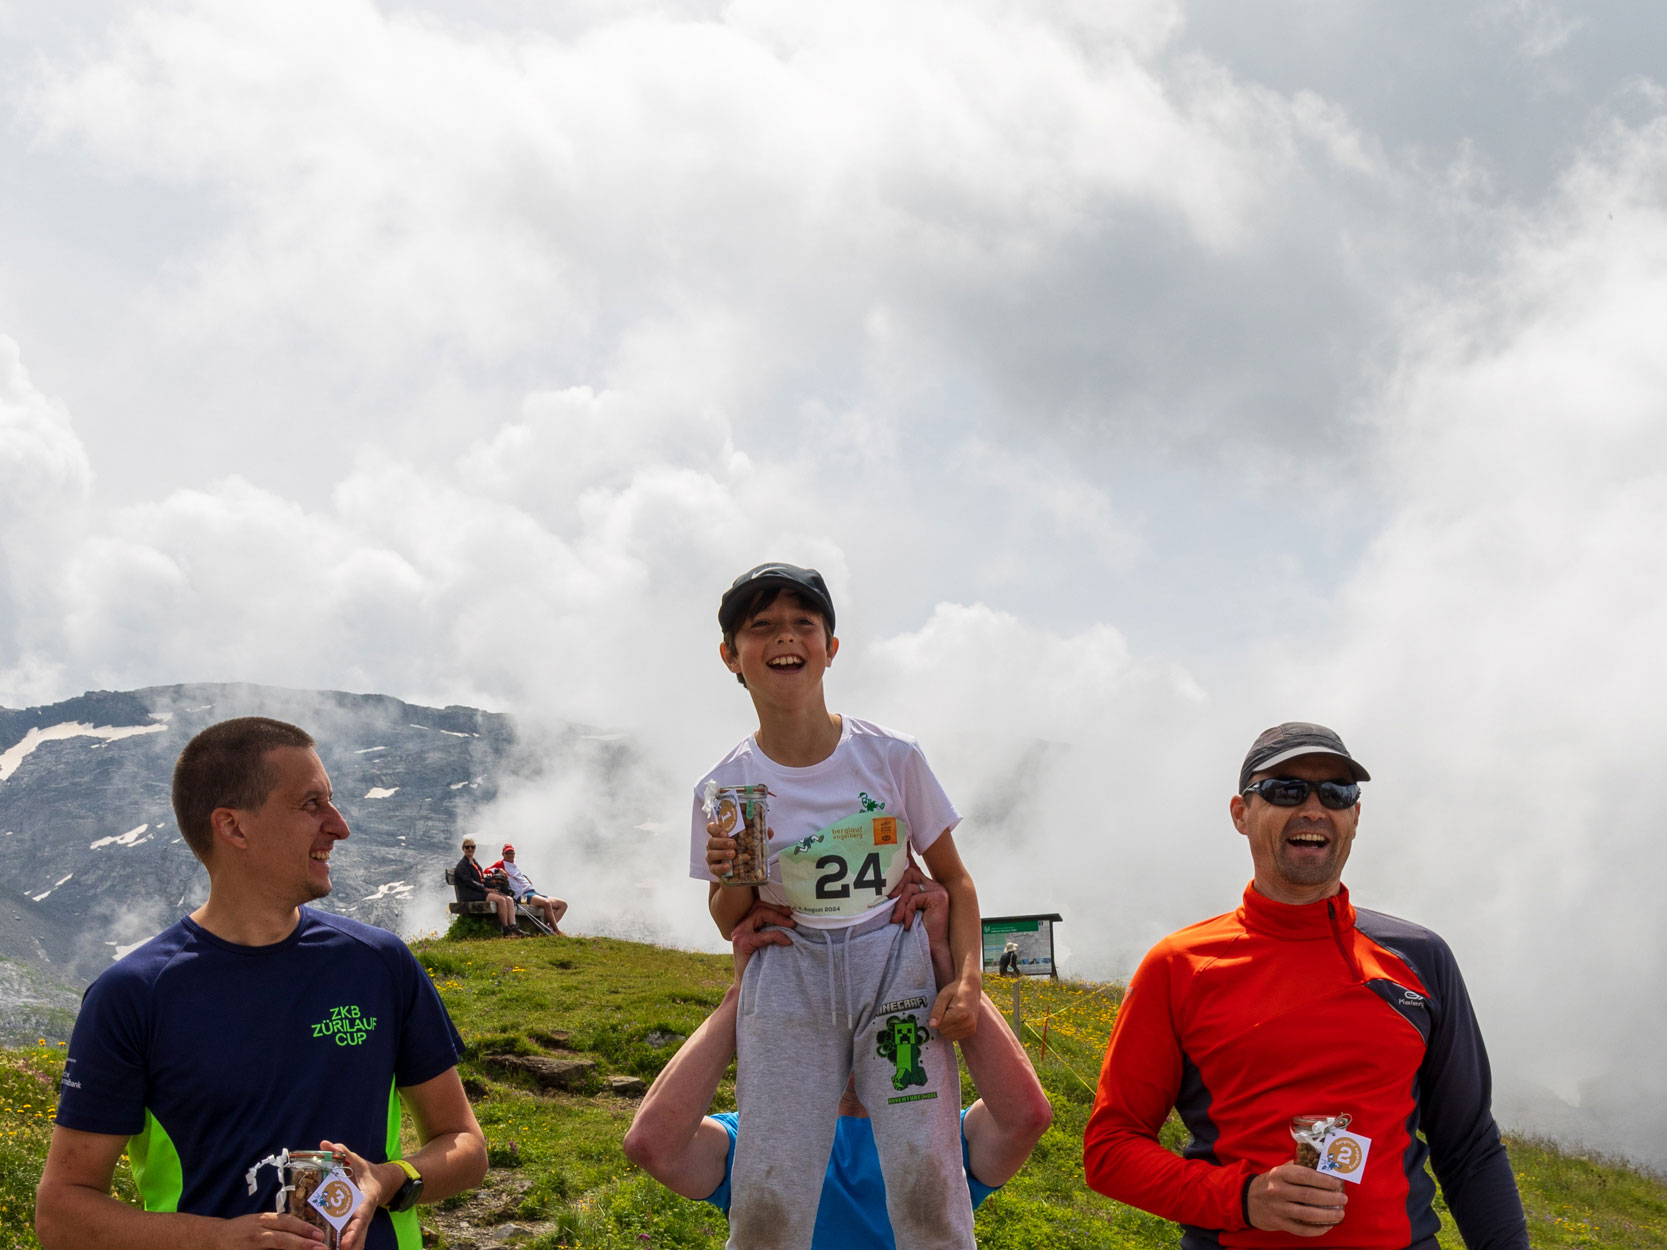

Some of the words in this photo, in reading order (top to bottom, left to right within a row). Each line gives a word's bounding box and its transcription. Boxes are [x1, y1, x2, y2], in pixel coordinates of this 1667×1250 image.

[816, 852, 887, 900] 24
[876, 996, 928, 1017] INECRAFT
[1398, 998, 1425, 1008] Kalenj
[330, 1005, 361, 1020] ZKB
[311, 1017, 377, 1037] ZÜRILAUF
[336, 1032, 367, 1046] CUP
[1337, 1146, 1352, 1165] 2
[330, 1189, 345, 1207] 3
